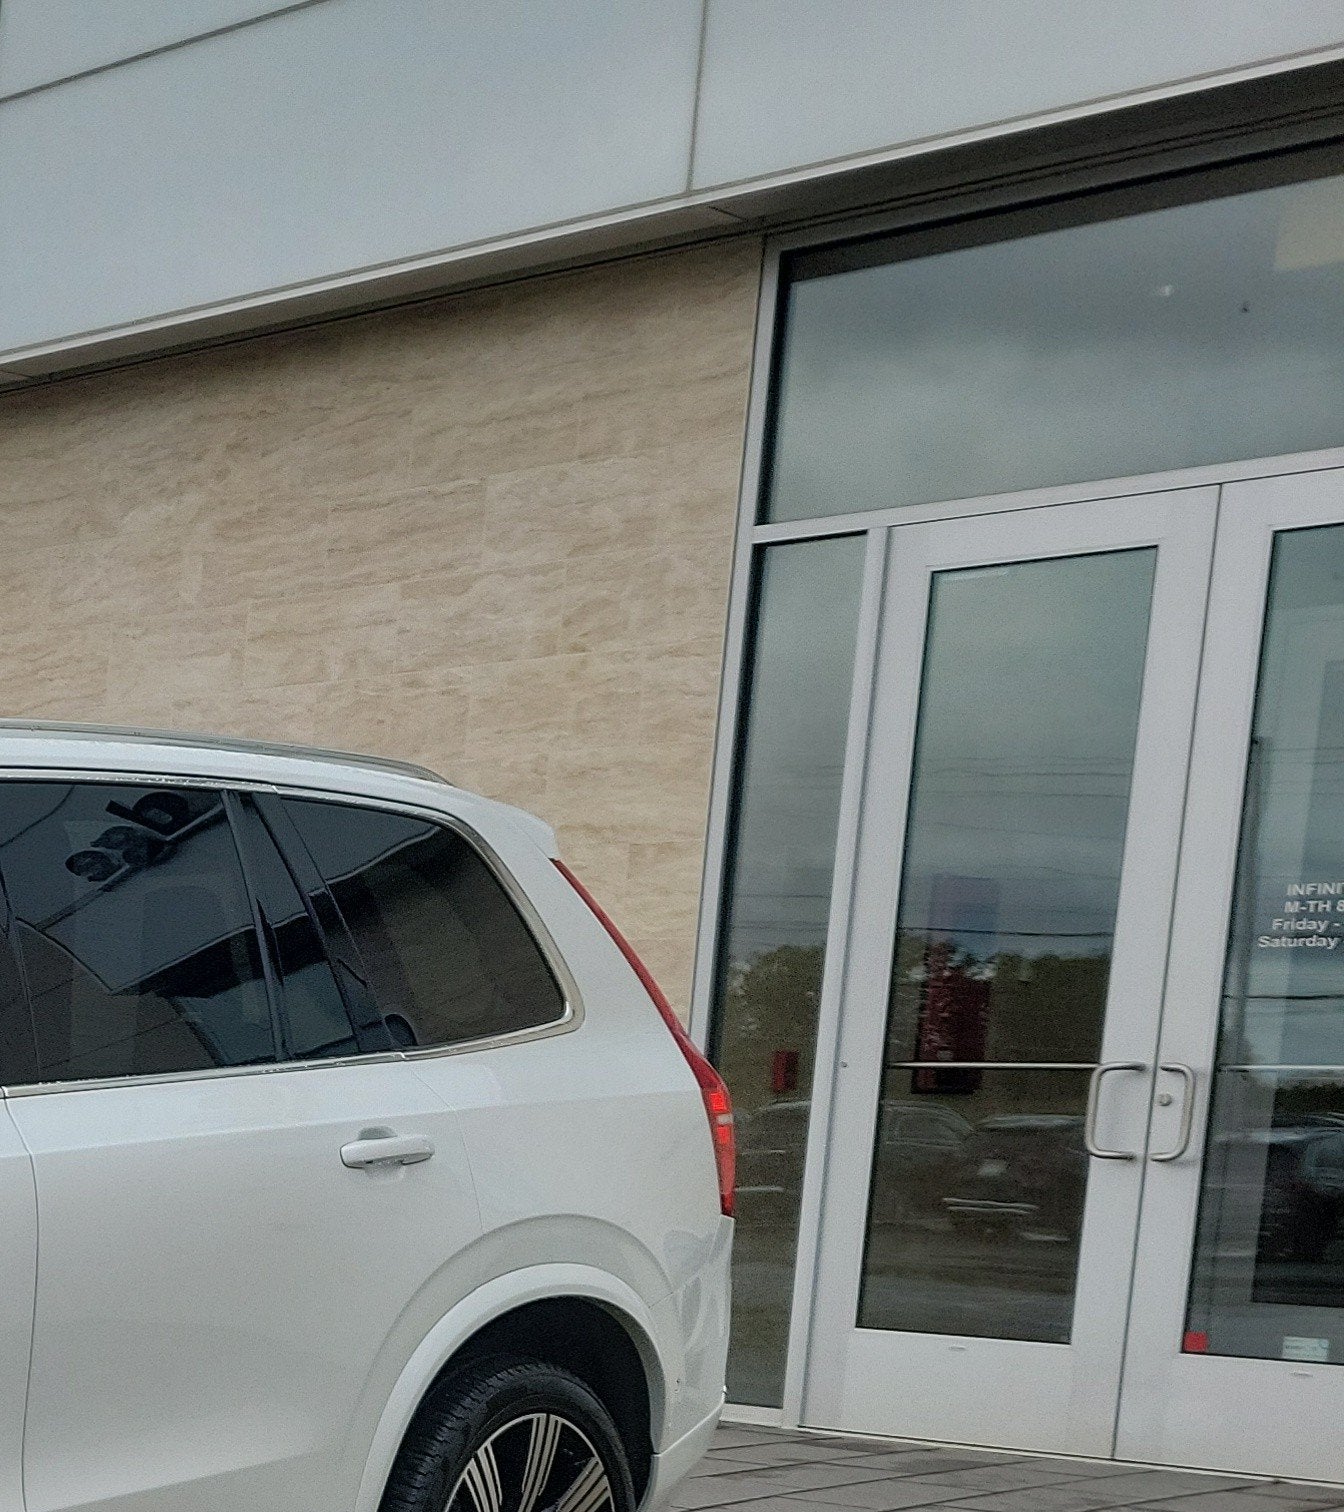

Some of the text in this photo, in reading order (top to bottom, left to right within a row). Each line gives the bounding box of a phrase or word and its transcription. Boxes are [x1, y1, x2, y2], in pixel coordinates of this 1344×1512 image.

[1284, 900, 1332, 913] M-TH
[1272, 917, 1330, 933] Friday
[1258, 935, 1341, 949] Saturday
